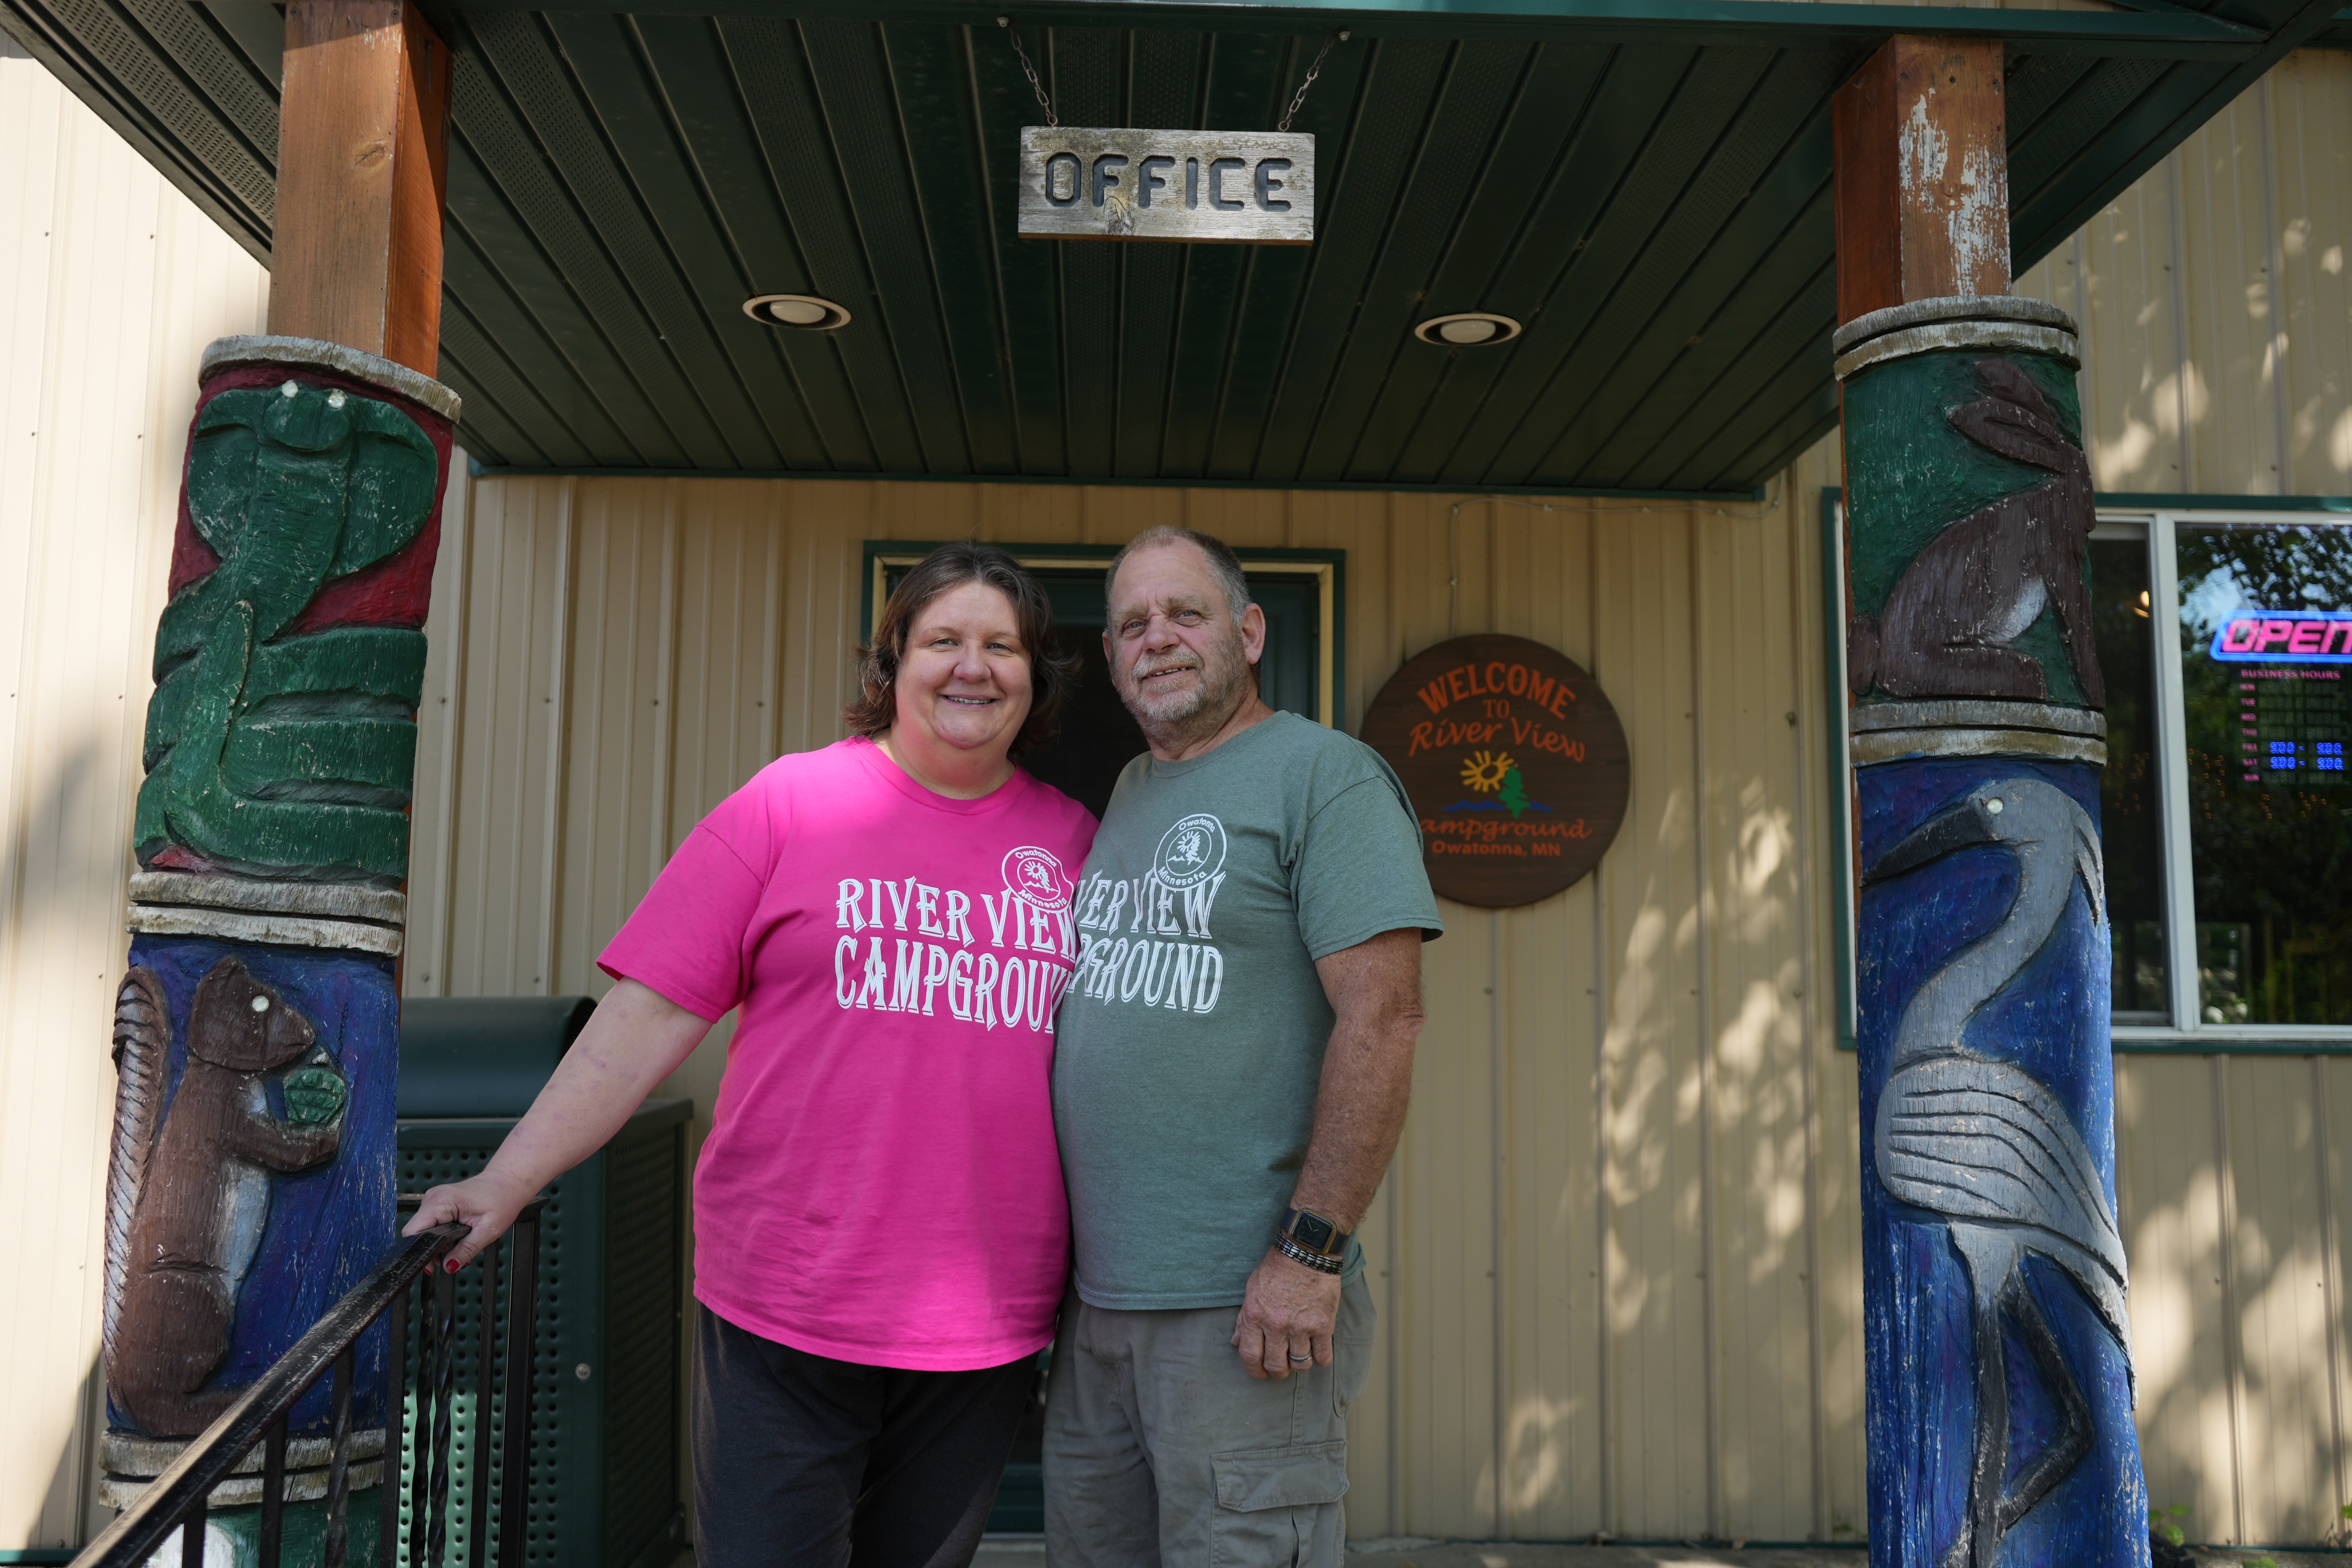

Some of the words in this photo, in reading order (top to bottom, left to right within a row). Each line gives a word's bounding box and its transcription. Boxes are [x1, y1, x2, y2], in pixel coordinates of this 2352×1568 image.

[1045, 151, 1292, 213] OFFICE
[2222, 618, 2352, 654] OPEN
[2241, 669, 2298, 679] BUSINESS
[2301, 670, 2341, 680] HOURS
[1416, 661, 1576, 720] WELCOME
[2239, 683, 2256, 691] MON
[1482, 699, 1510, 719] TO
[2241, 698, 2256, 707] TUE
[2241, 713, 2257, 722] WED
[1408, 717, 1503, 758] River
[1510, 716, 1585, 762] View
[2242, 728, 2258, 737] THU
[2242, 743, 2258, 752] FRI
[2242, 758, 2258, 767] SAT
[2243, 773, 2260, 782] SUN
[1178, 817, 1216, 833] Owatonna
[1421, 818, 1593, 842] ampground
[1015, 849, 1057, 867] Owatonna
[1432, 840, 1528, 857] Owatonna,
[1532, 843, 1561, 857] MN
[1158, 866, 1207, 886] Minnesota
[1018, 889, 1068, 909] Minnesota
[1074, 869, 1129, 936] VER
[1130, 867, 1226, 939] VIEW
[835, 875, 976, 948] RIVER
[980, 888, 1076, 964] VIEW
[834, 934, 1073, 1034] CAMPGROUN
